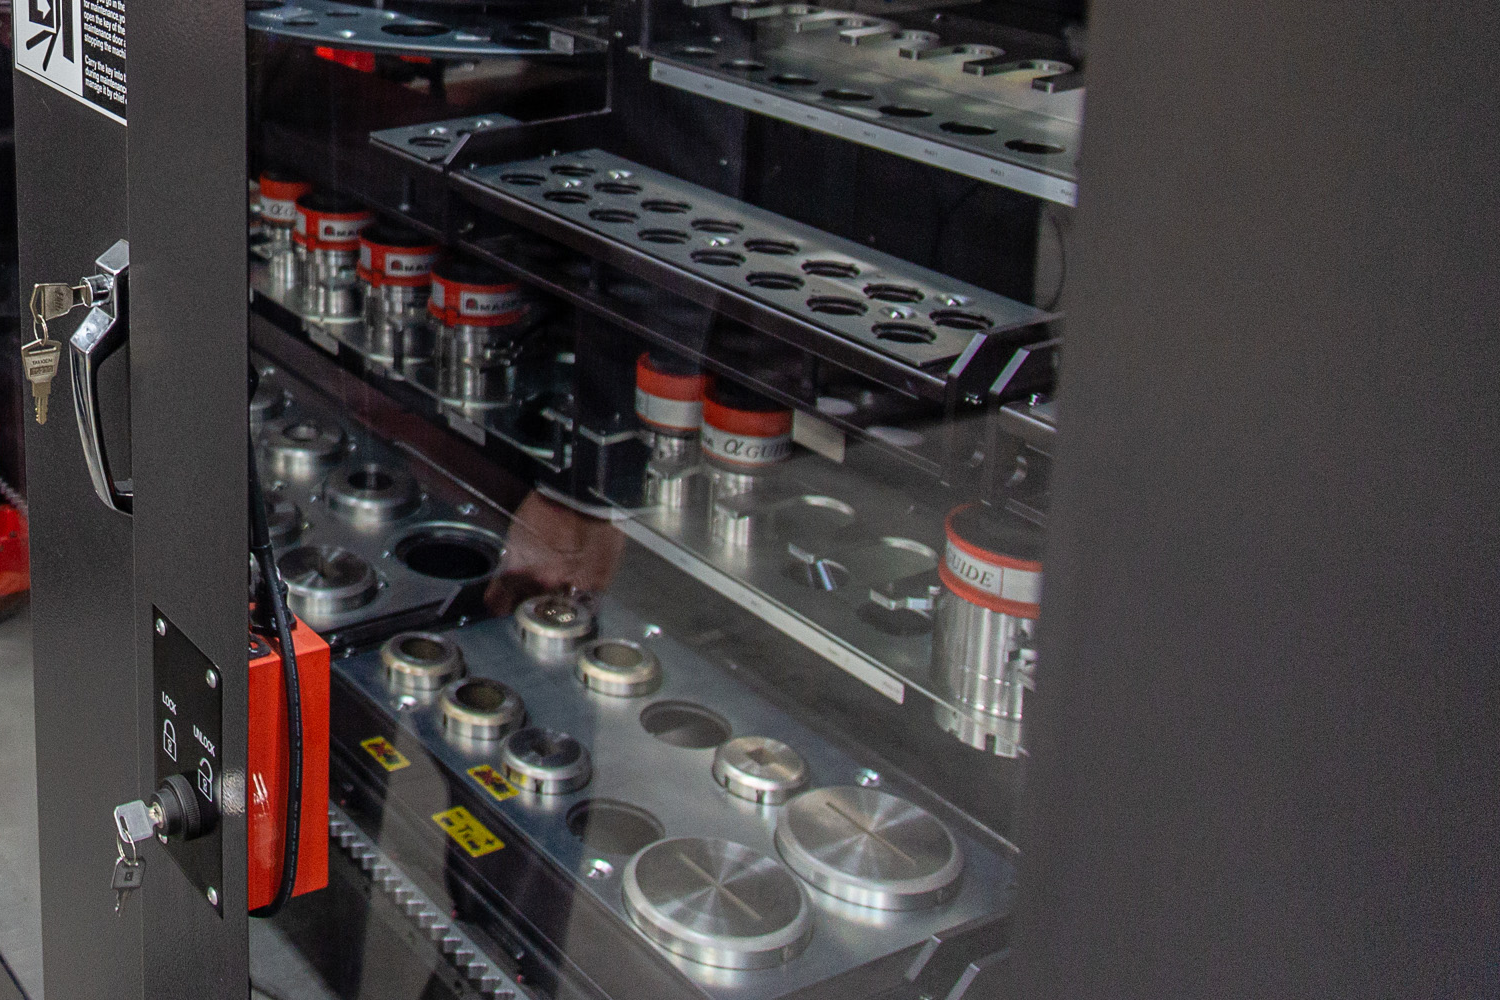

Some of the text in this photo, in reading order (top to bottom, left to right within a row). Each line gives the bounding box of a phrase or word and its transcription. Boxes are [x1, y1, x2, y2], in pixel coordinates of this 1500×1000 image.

[84, 12, 95, 22] open
[103, 17, 111, 31] key
[112, 22, 117, 32] of
[84, 23, 123, 45] maintenance door
[84, 33, 103, 51] stopping
[112, 46, 126, 59] machi
[85, 55, 97, 70] Carry
[105, 64, 113, 78] key
[114, 68, 123, 80] into
[85, 67, 127, 94] during maintenanc
[85, 78, 102, 94] manage
[103, 85, 106, 95] it
[107, 87, 112, 100] by
[162, 691, 177, 716] LOCK
[193, 724, 216, 758] UNLOCK
